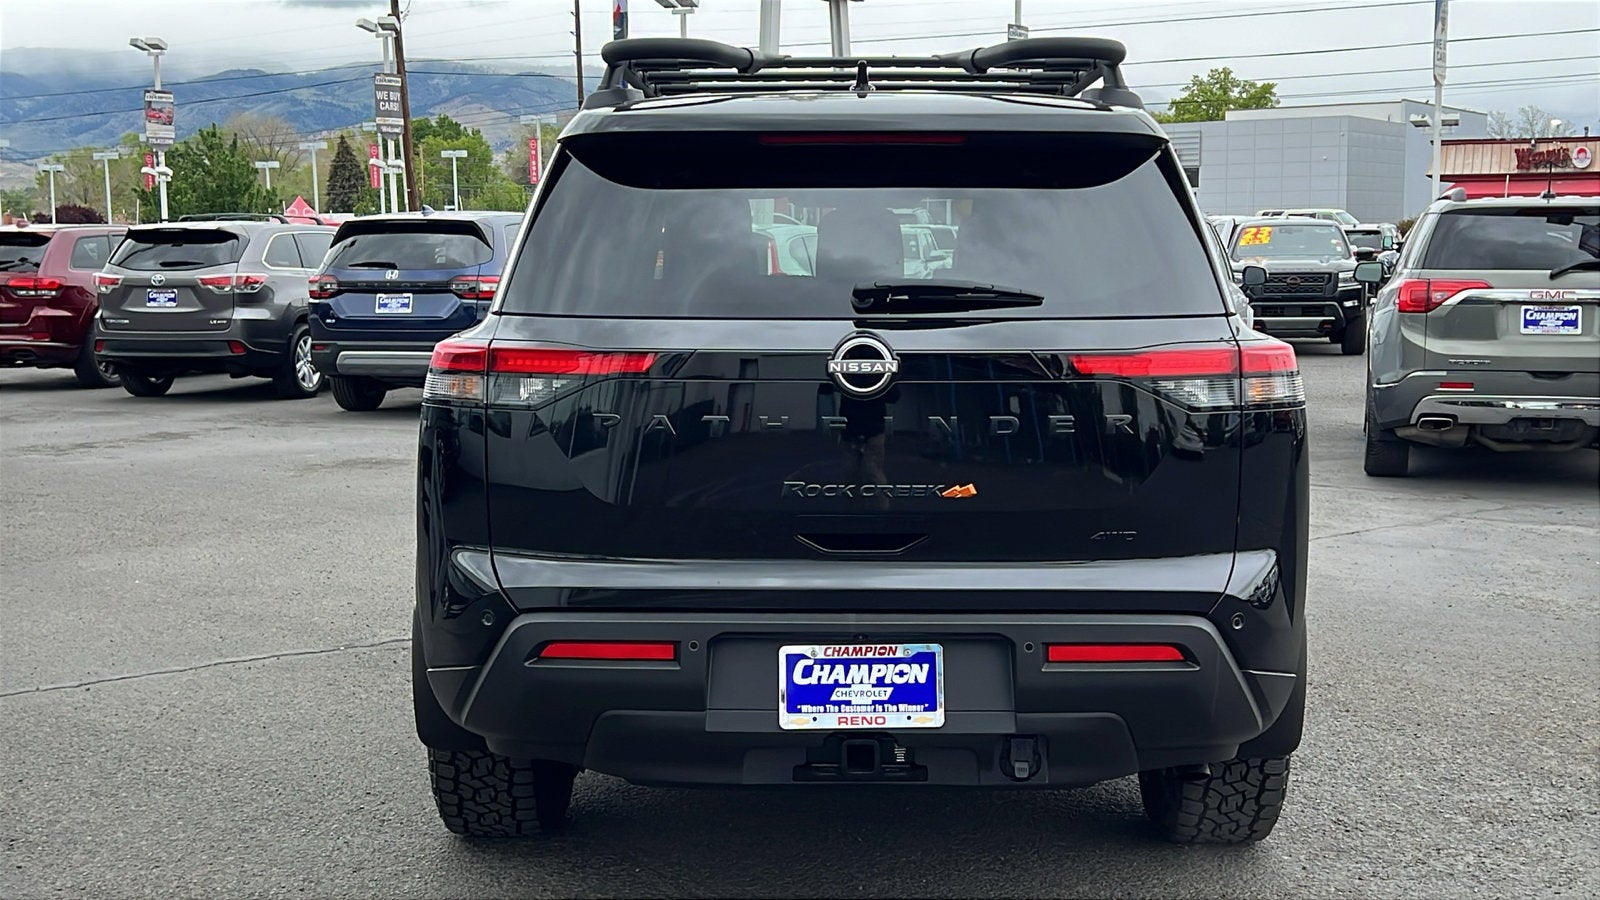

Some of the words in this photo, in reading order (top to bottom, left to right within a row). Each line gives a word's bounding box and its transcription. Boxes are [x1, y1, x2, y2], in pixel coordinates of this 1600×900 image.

[376, 91, 388, 100] WE
[390, 91, 400, 101] BUY
[1242, 226, 1272, 240] 23
[1530, 291, 1576, 299] GMC
[1526, 311, 1576, 320] CHAMPION
[830, 362, 897, 372] NISSAN
[592, 413, 1134, 437] PATHFINDER
[782, 481, 856, 498] ROCK
[860, 484, 945, 498] CREEK
[823, 645, 898, 657] CHAMPION
[793, 659, 930, 685] CHAMPION
[835, 689, 888, 698] CHEVROLET
[797, 704, 824, 713] "Where
[826, 704, 839, 713] The
[840, 704, 875, 713] Customer
[884, 703, 897, 712] The
[837, 716, 887, 726] RENO
